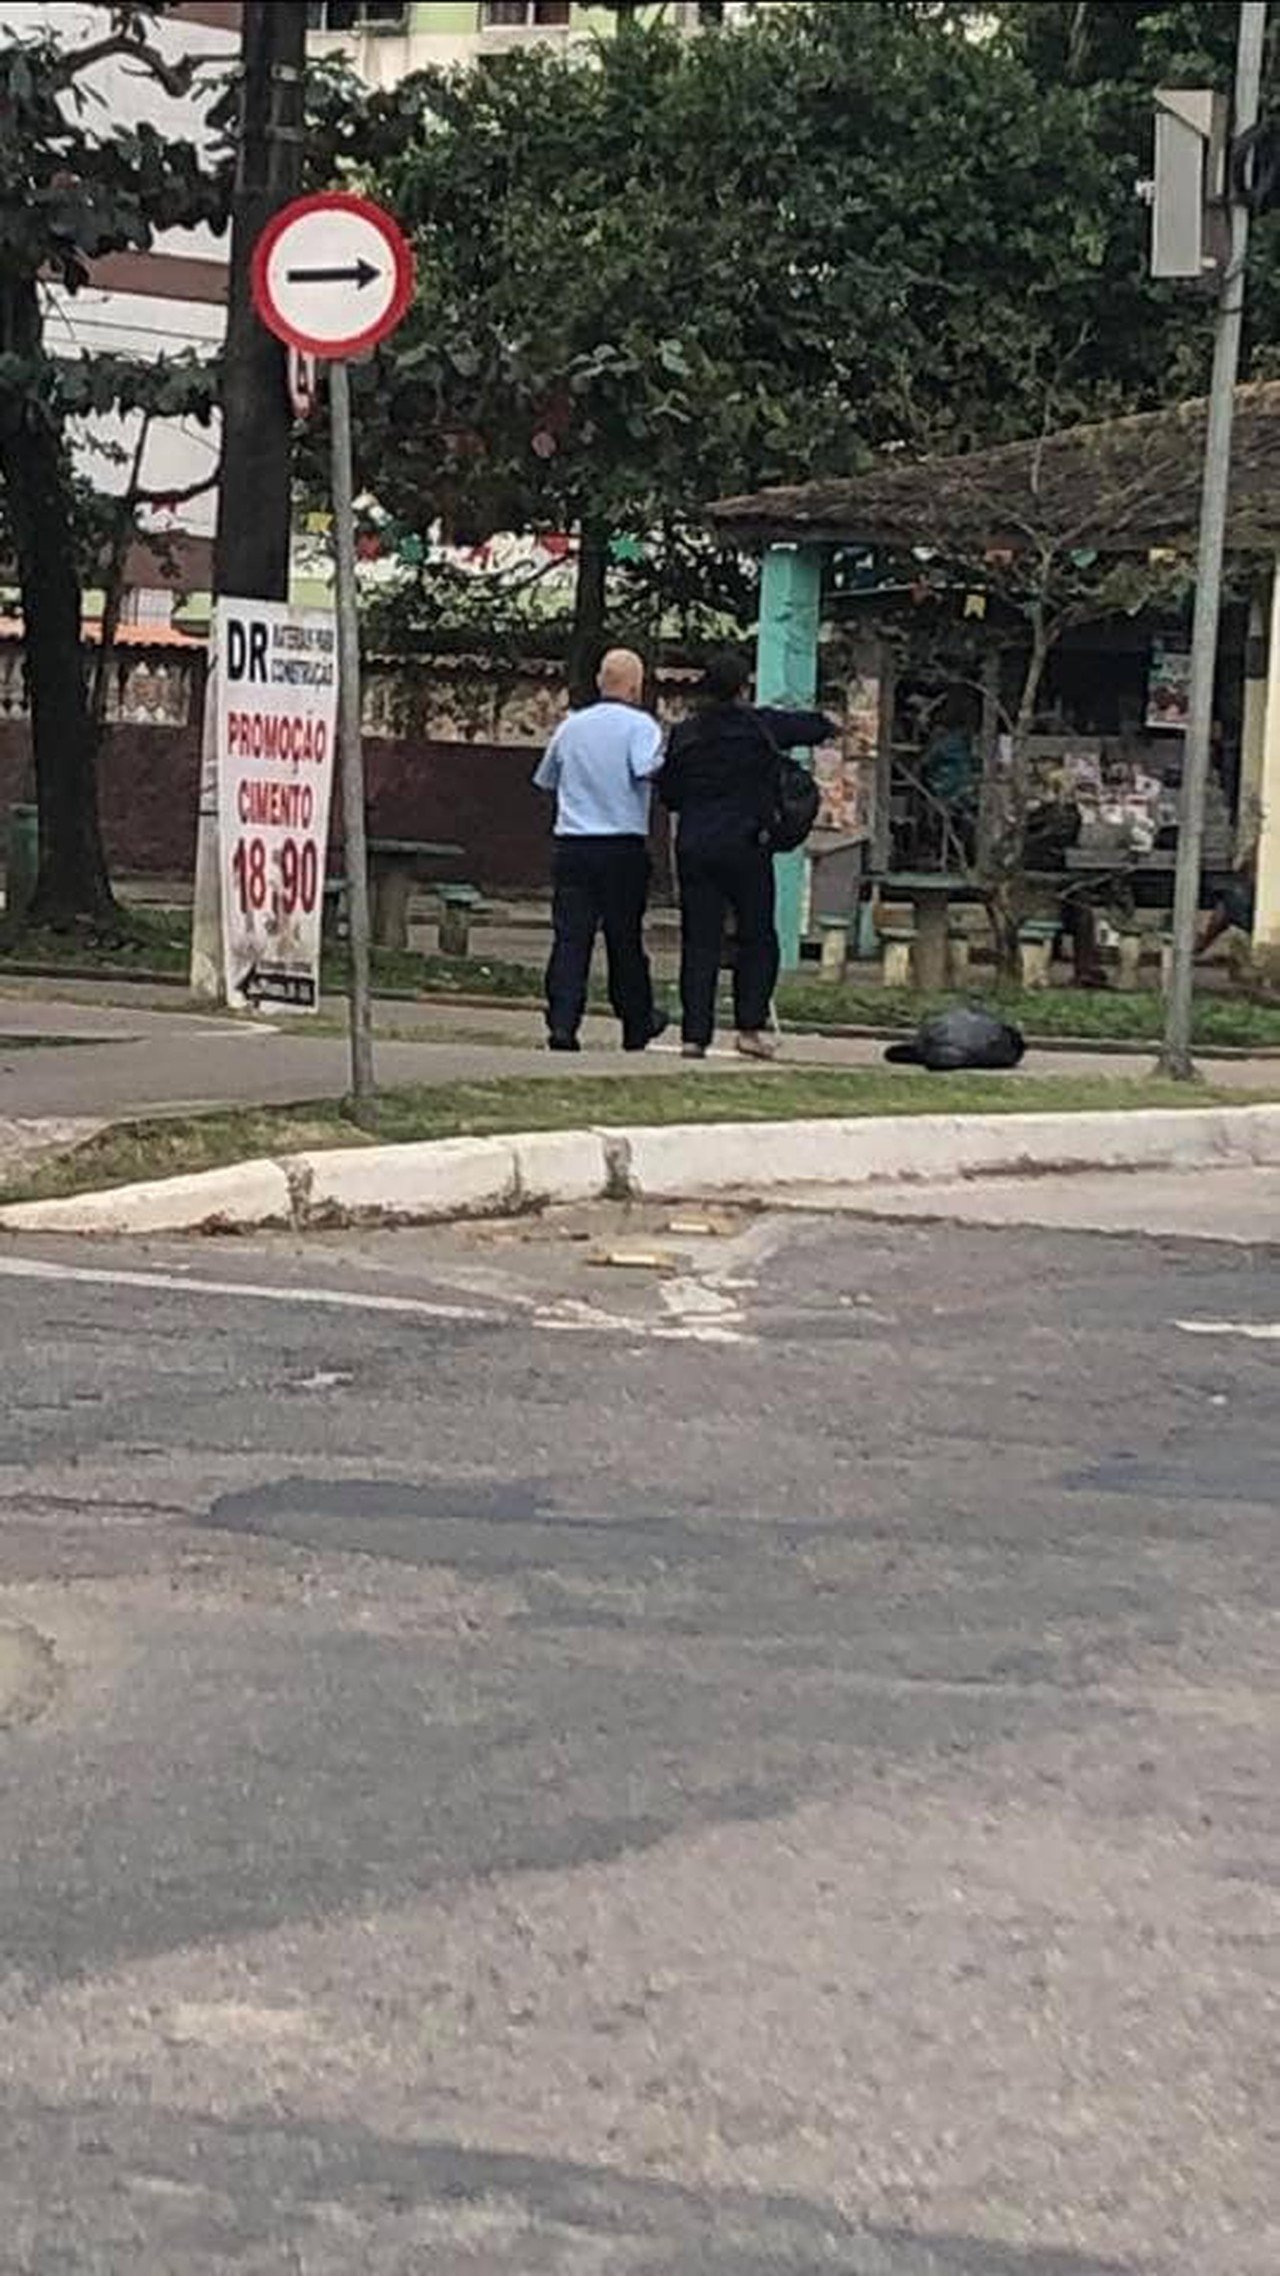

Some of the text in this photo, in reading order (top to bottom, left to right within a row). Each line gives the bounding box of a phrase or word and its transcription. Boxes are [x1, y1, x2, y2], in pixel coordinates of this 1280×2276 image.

[227, 619, 267, 683] DR
[228, 710, 326, 774] PROMOÇÃO
[238, 779, 313, 829] CIMENTO
